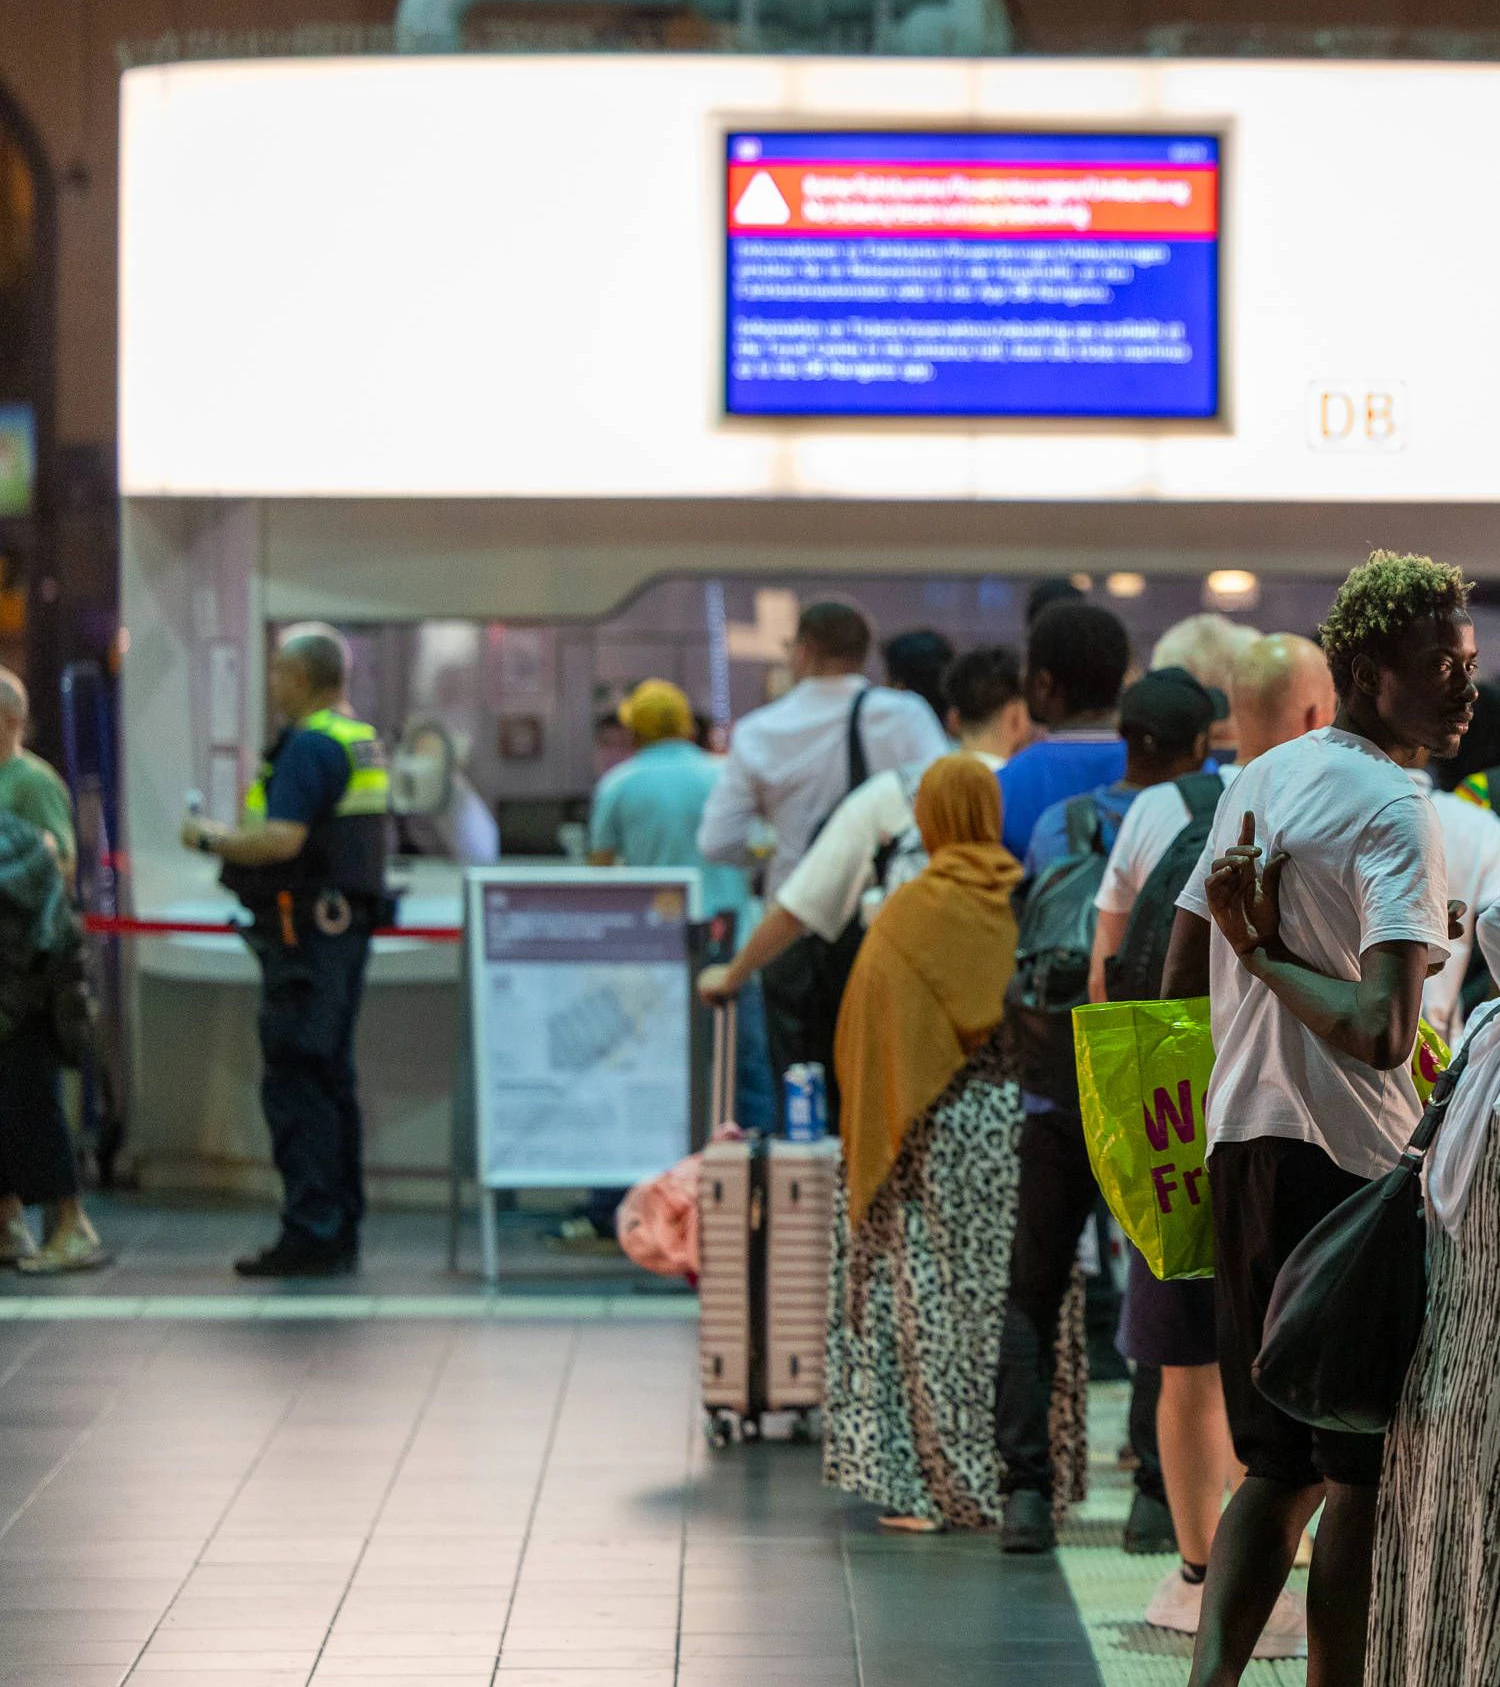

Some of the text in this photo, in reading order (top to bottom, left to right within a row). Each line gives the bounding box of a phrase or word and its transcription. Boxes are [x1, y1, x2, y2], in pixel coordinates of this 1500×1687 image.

[1319, 391, 1396, 440] DB
[1142, 1079, 1208, 1151] W
[1151, 1163, 1202, 1214] Fr
